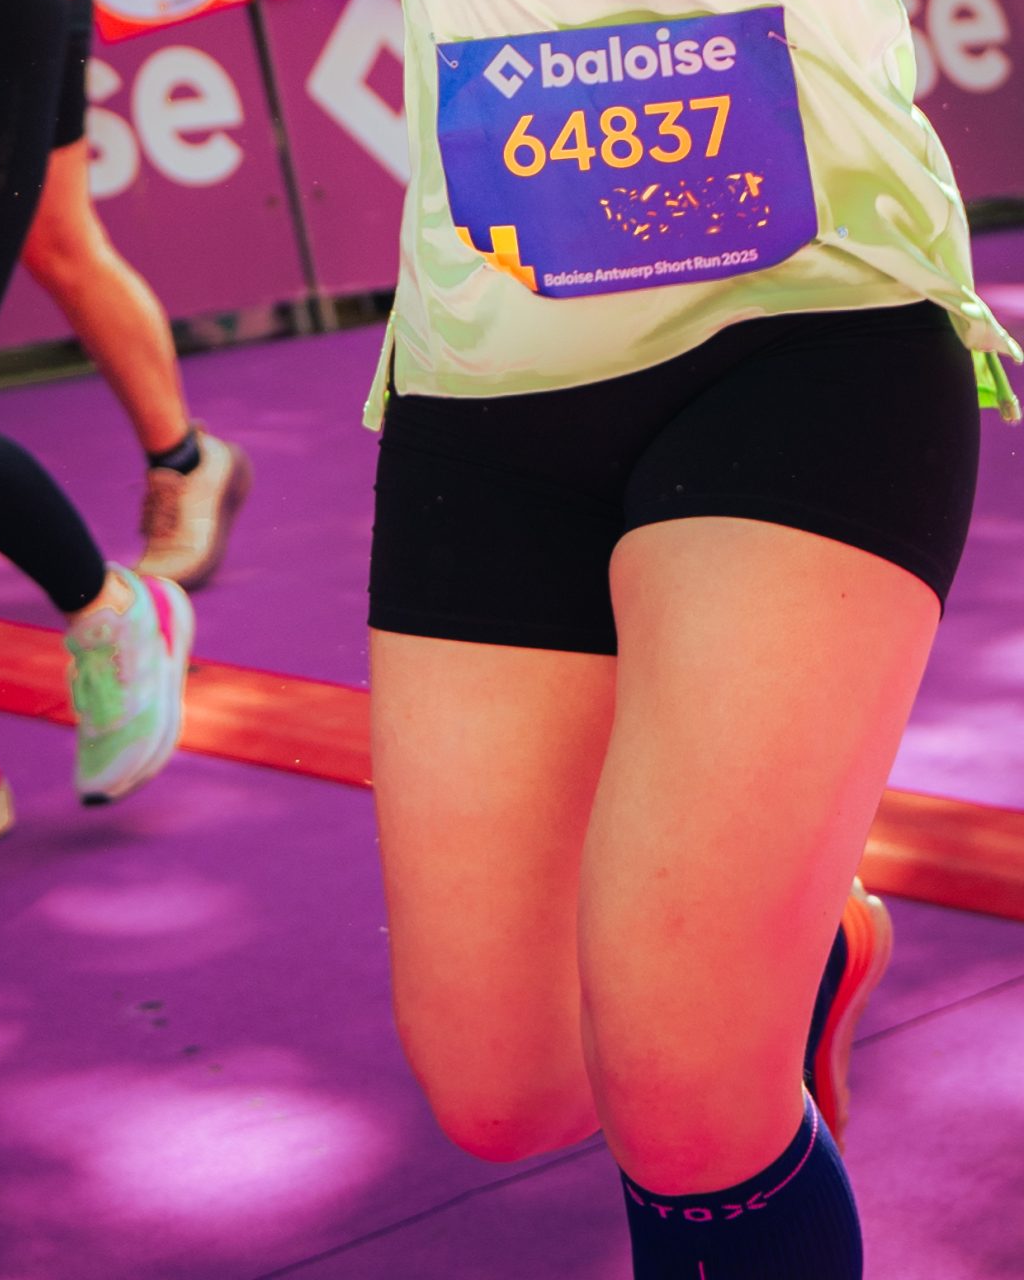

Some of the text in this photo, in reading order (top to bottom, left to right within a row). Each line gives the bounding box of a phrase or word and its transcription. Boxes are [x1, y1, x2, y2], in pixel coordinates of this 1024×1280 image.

[539, 27, 737, 88] baloise
[503, 95, 731, 177] 64837
[543, 248, 759, 287] Baloise Antwerp Short Run 2025
